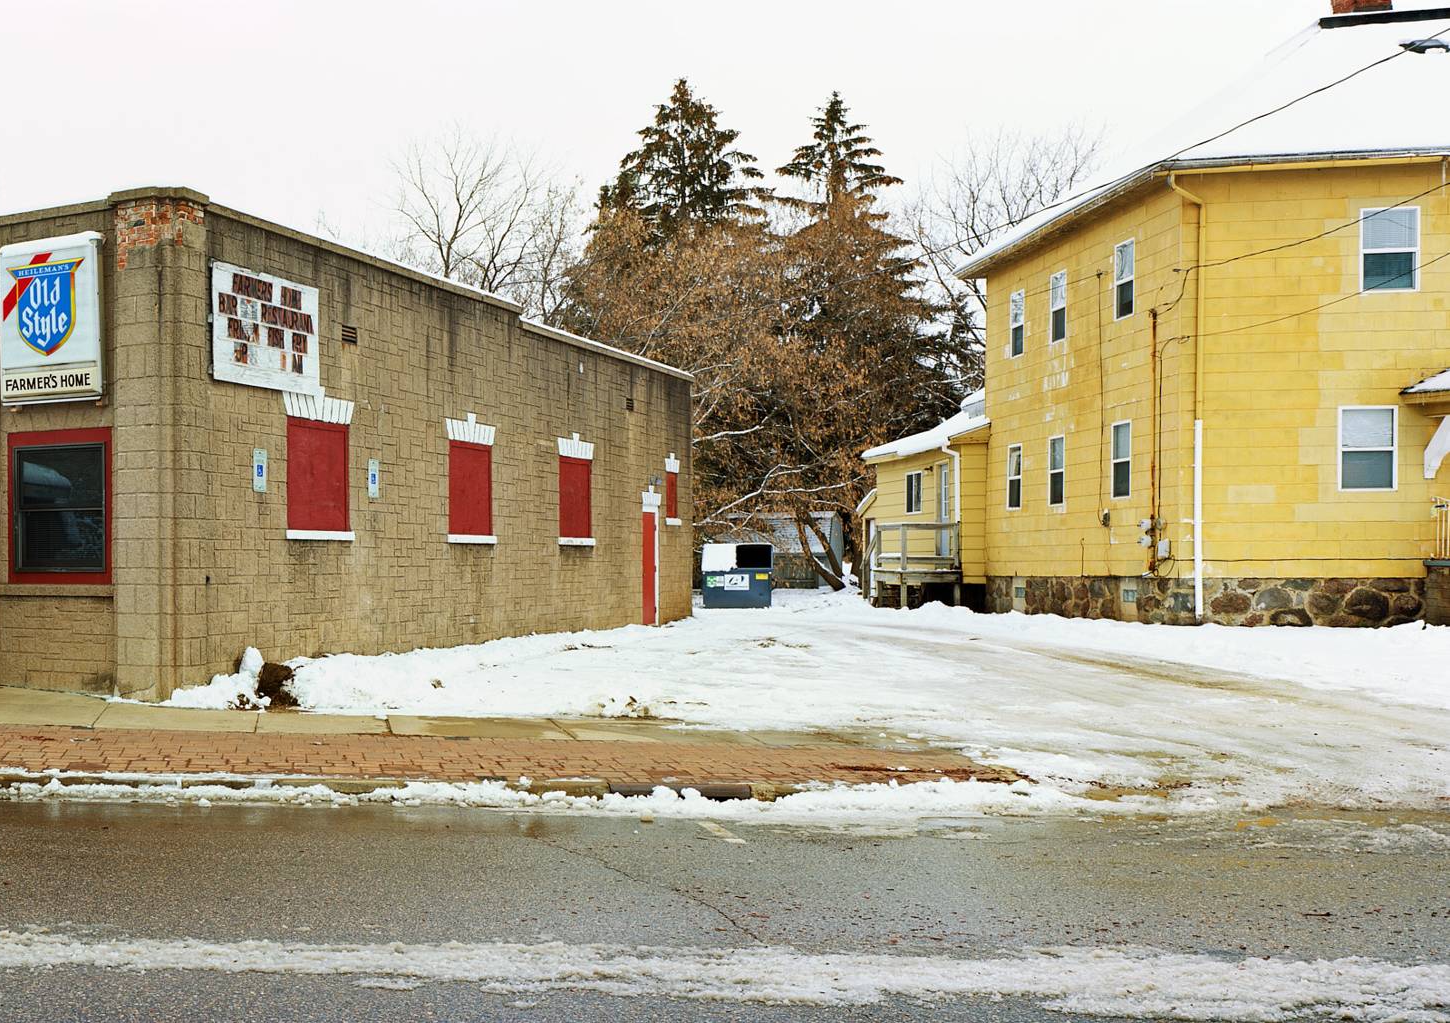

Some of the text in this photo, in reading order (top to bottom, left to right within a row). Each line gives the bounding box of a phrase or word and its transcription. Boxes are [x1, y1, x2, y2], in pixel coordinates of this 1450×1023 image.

[18, 264, 70, 277] HEILEMAN'S
[29, 276, 61, 308] Old
[22, 306, 68, 347] Style
[5, 373, 91, 392] FARMER'S HOME
